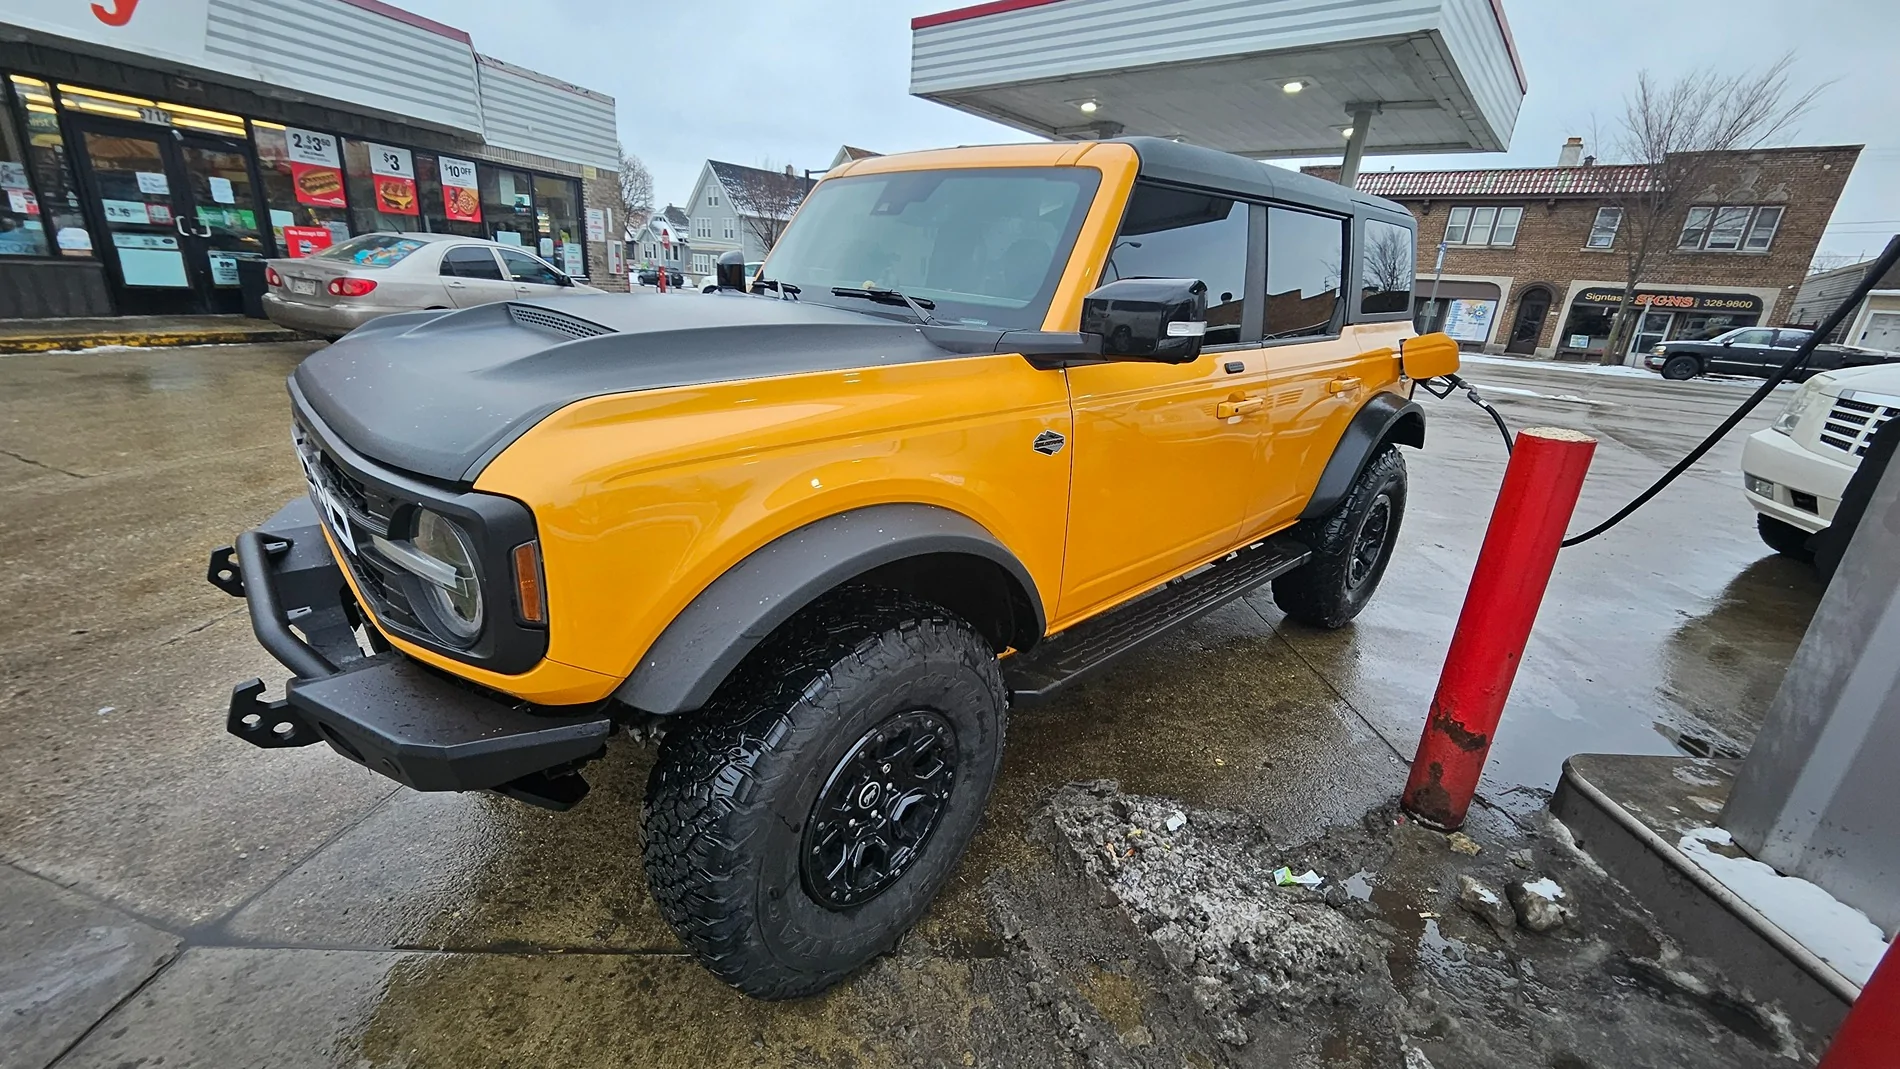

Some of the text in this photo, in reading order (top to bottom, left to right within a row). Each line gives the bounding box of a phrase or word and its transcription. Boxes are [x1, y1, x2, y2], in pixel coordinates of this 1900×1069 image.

[138, 107, 170, 123] 5712
[292, 133, 303, 149] 2
[383, 152, 400, 171] $3
[444, 163, 472, 178] $10 OFF
[1585, 292, 1635, 303] Signtasc
[1634, 293, 1695, 308] SIGNS
[1703, 299, 1753, 309] 328-9800
